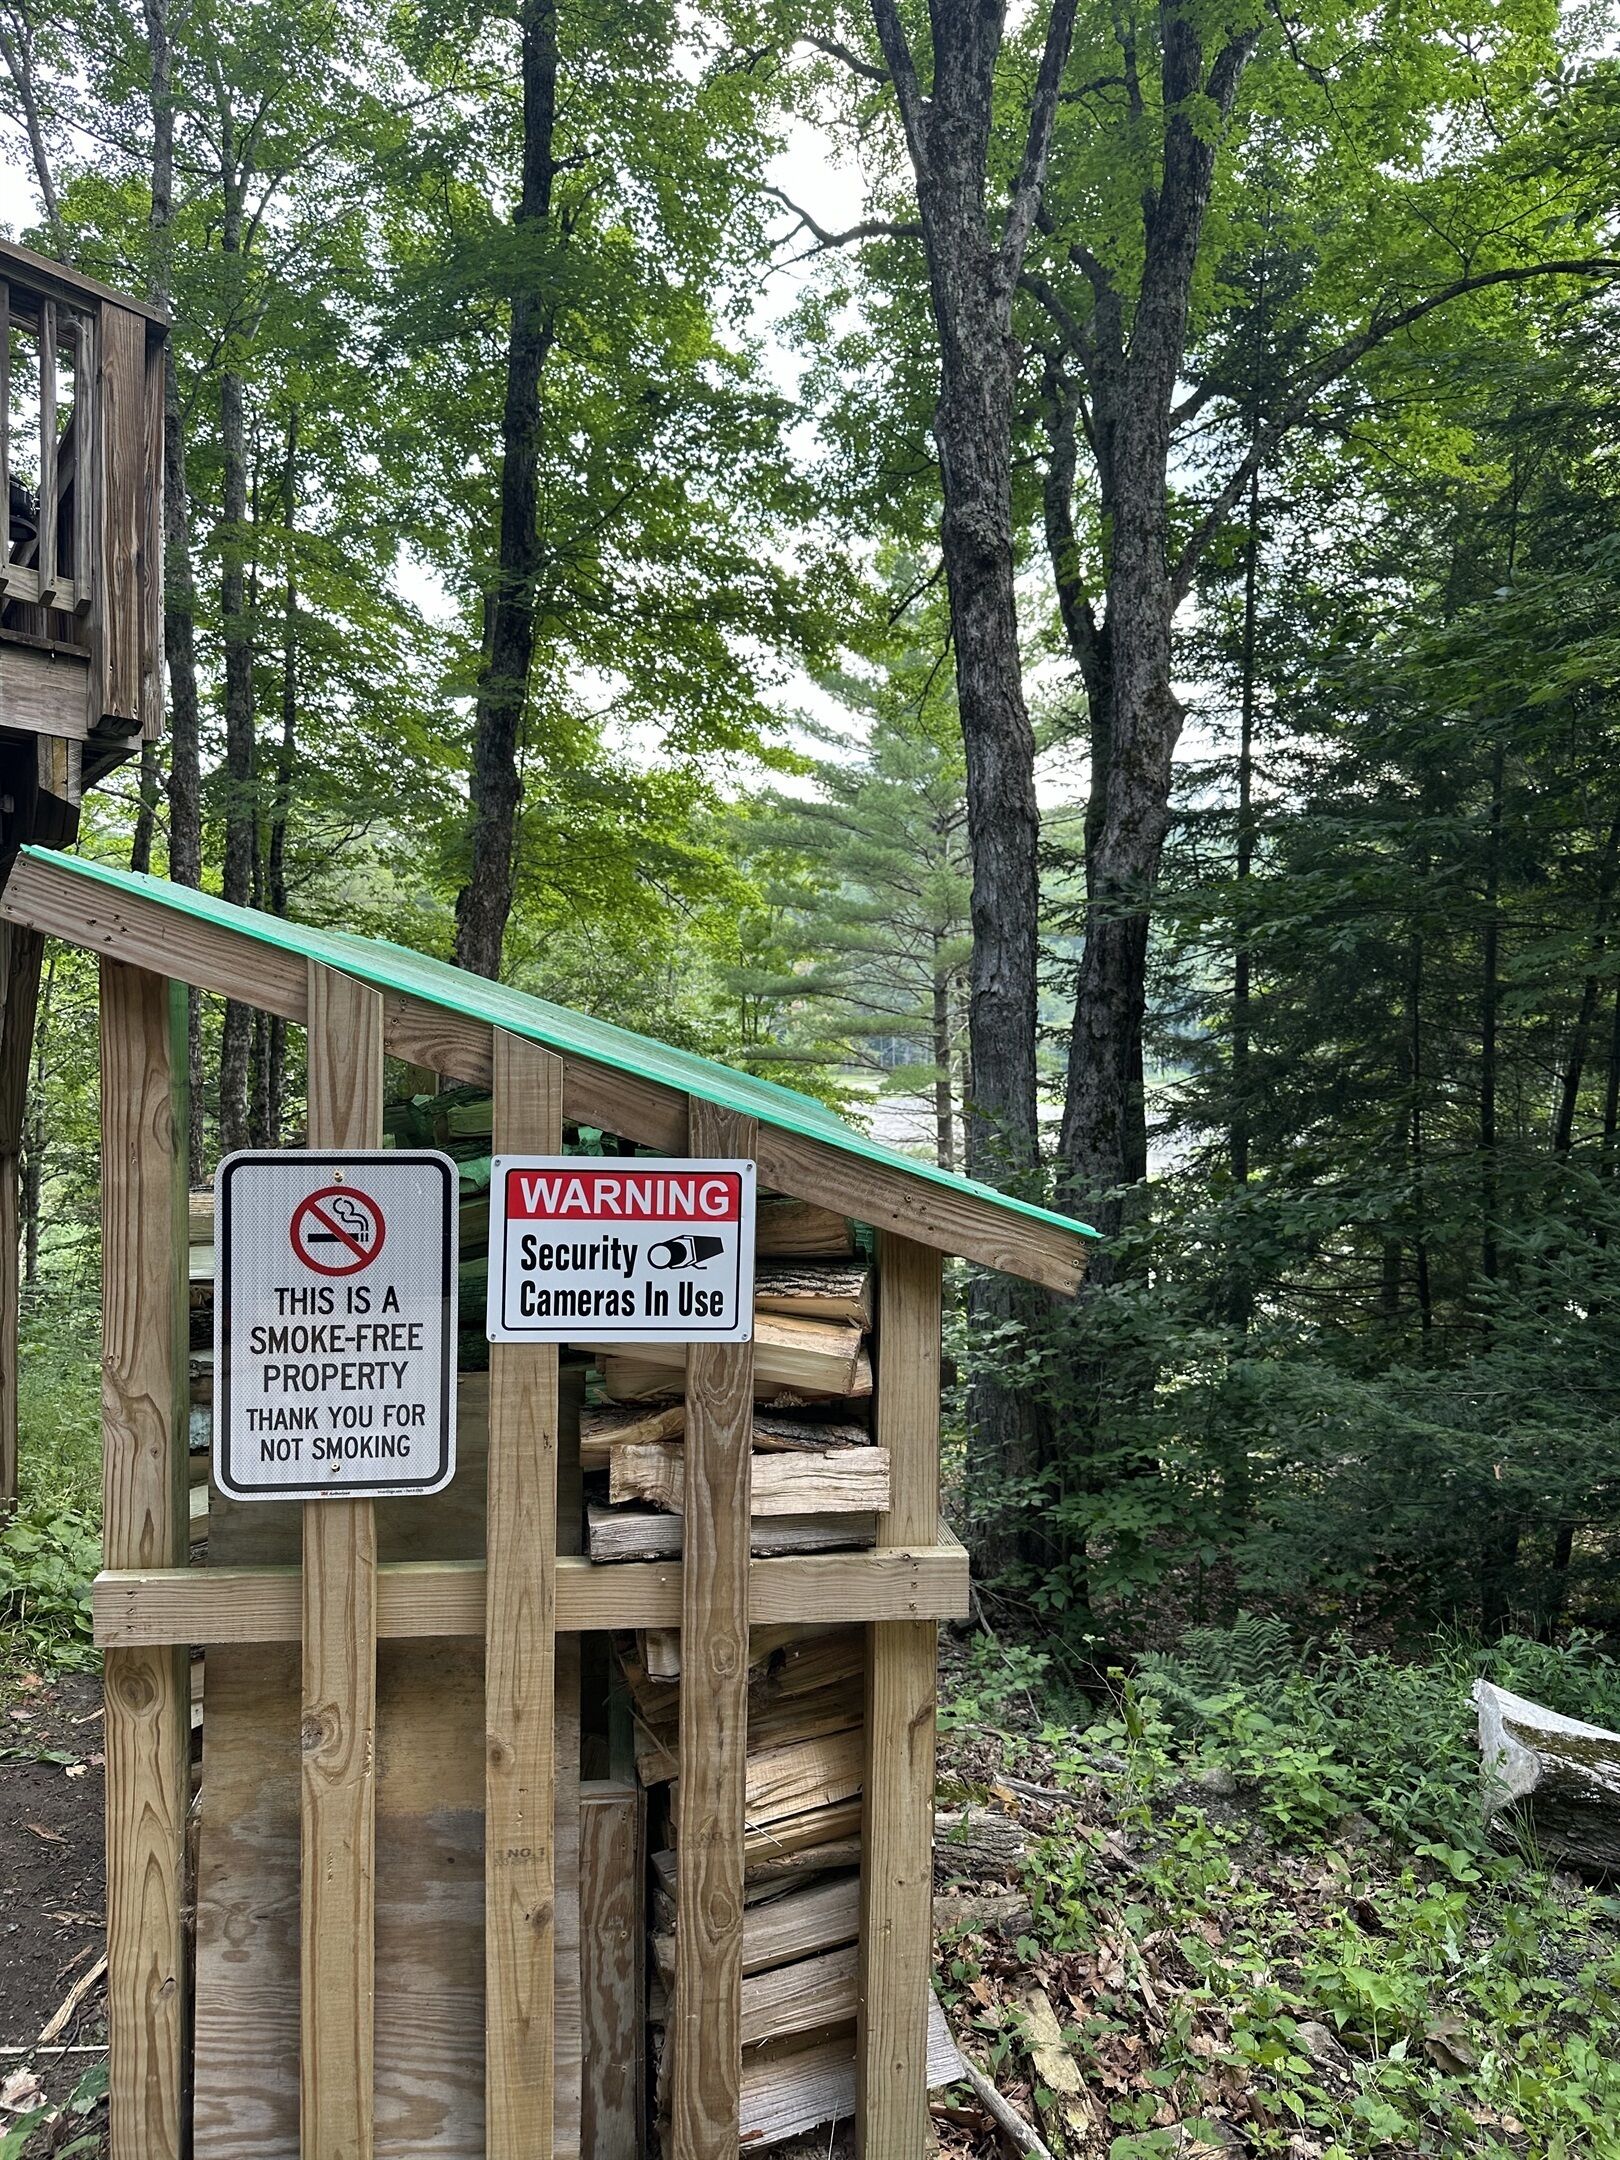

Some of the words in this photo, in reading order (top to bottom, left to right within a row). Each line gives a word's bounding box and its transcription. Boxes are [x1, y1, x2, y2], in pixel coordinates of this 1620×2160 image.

[520, 1177, 729, 1217] WARNING
[520, 1233, 638, 1279] Security
[274, 1287, 335, 1316] THIS
[346, 1286, 371, 1315] IS
[381, 1286, 400, 1314] A
[520, 1279, 636, 1317] Cameras
[644, 1280, 669, 1317] In
[678, 1280, 724, 1318] Use
[249, 1322, 424, 1355] SMOKE-FREE
[263, 1360, 409, 1393] PROPERTY
[245, 1406, 319, 1432] THANK
[327, 1405, 373, 1429] YOU
[383, 1403, 426, 1428] FOR
[260, 1437, 304, 1462] NOT
[311, 1434, 411, 1461] SMOKING
